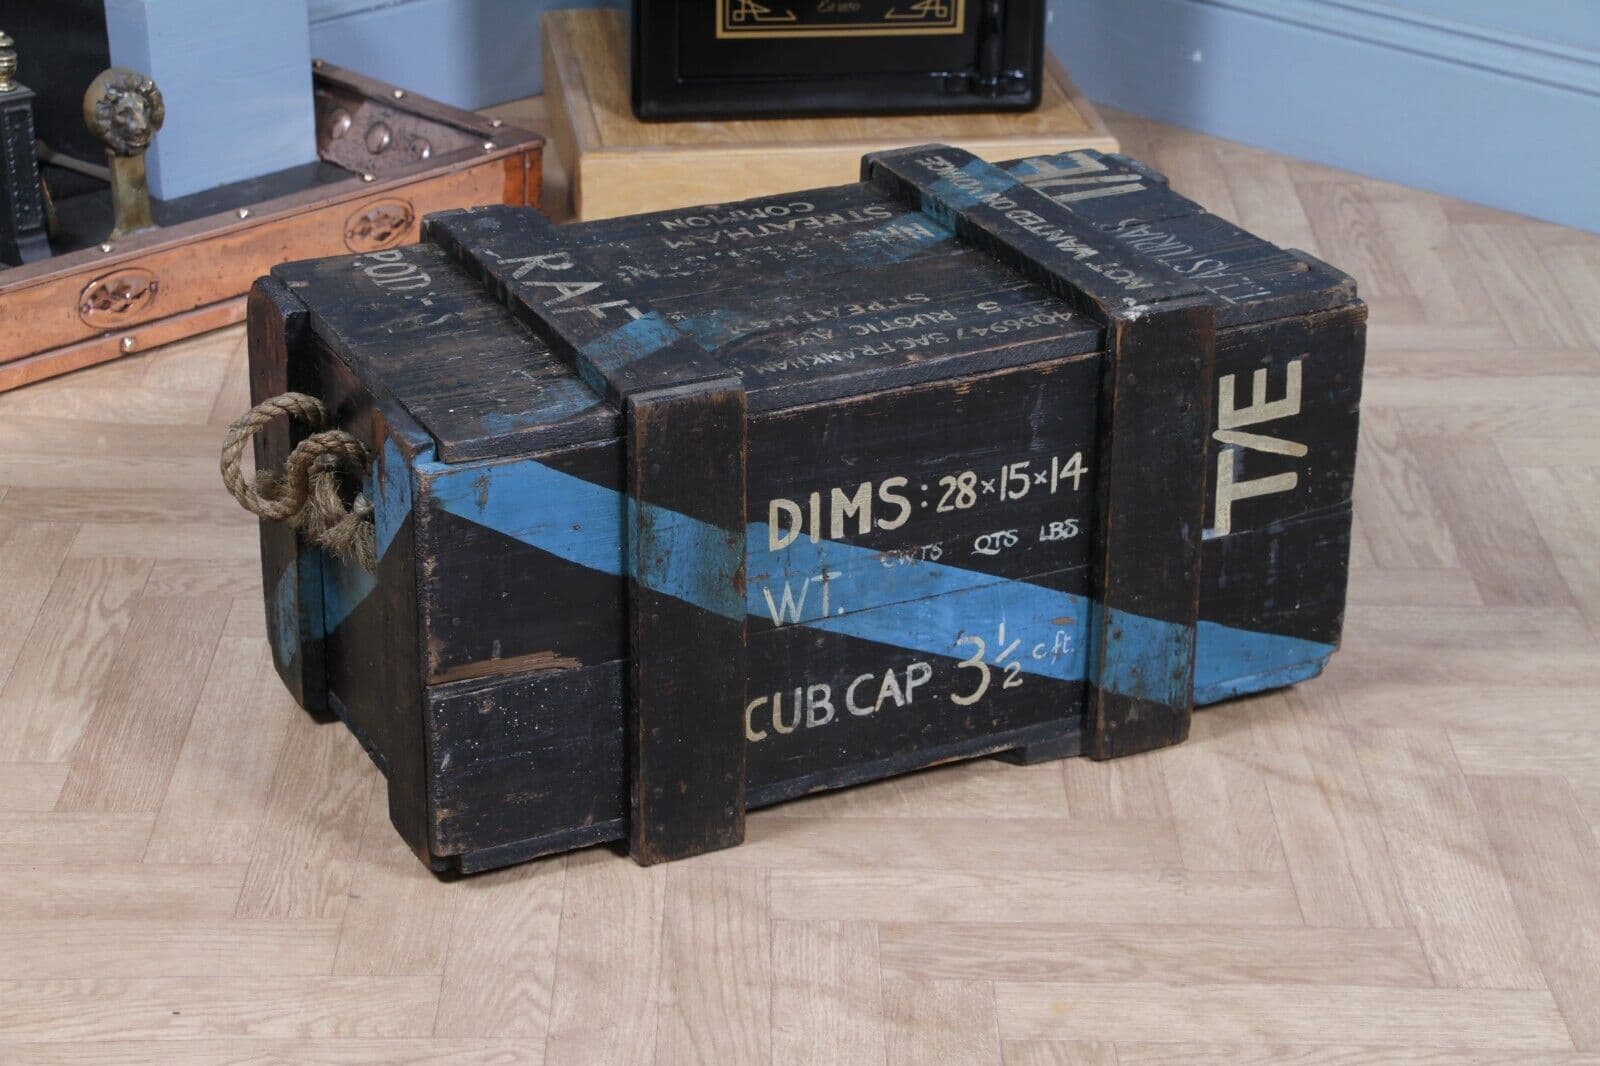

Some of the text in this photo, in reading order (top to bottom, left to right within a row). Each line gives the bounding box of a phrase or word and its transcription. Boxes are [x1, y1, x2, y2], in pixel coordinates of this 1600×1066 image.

[979, 191, 1019, 211] ON
[661, 205, 893, 250] STREATHAM
[1005, 209, 1099, 261] WANTED
[1099, 217, 1243, 280] ASTURIAS
[1085, 262, 1154, 291] NOT
[847, 309, 958, 336] RUSTIC
[956, 310, 1073, 340] 4036947
[769, 476, 929, 552] DIMS:
[970, 529, 1020, 556] QTS
[1038, 518, 1080, 542] LBS
